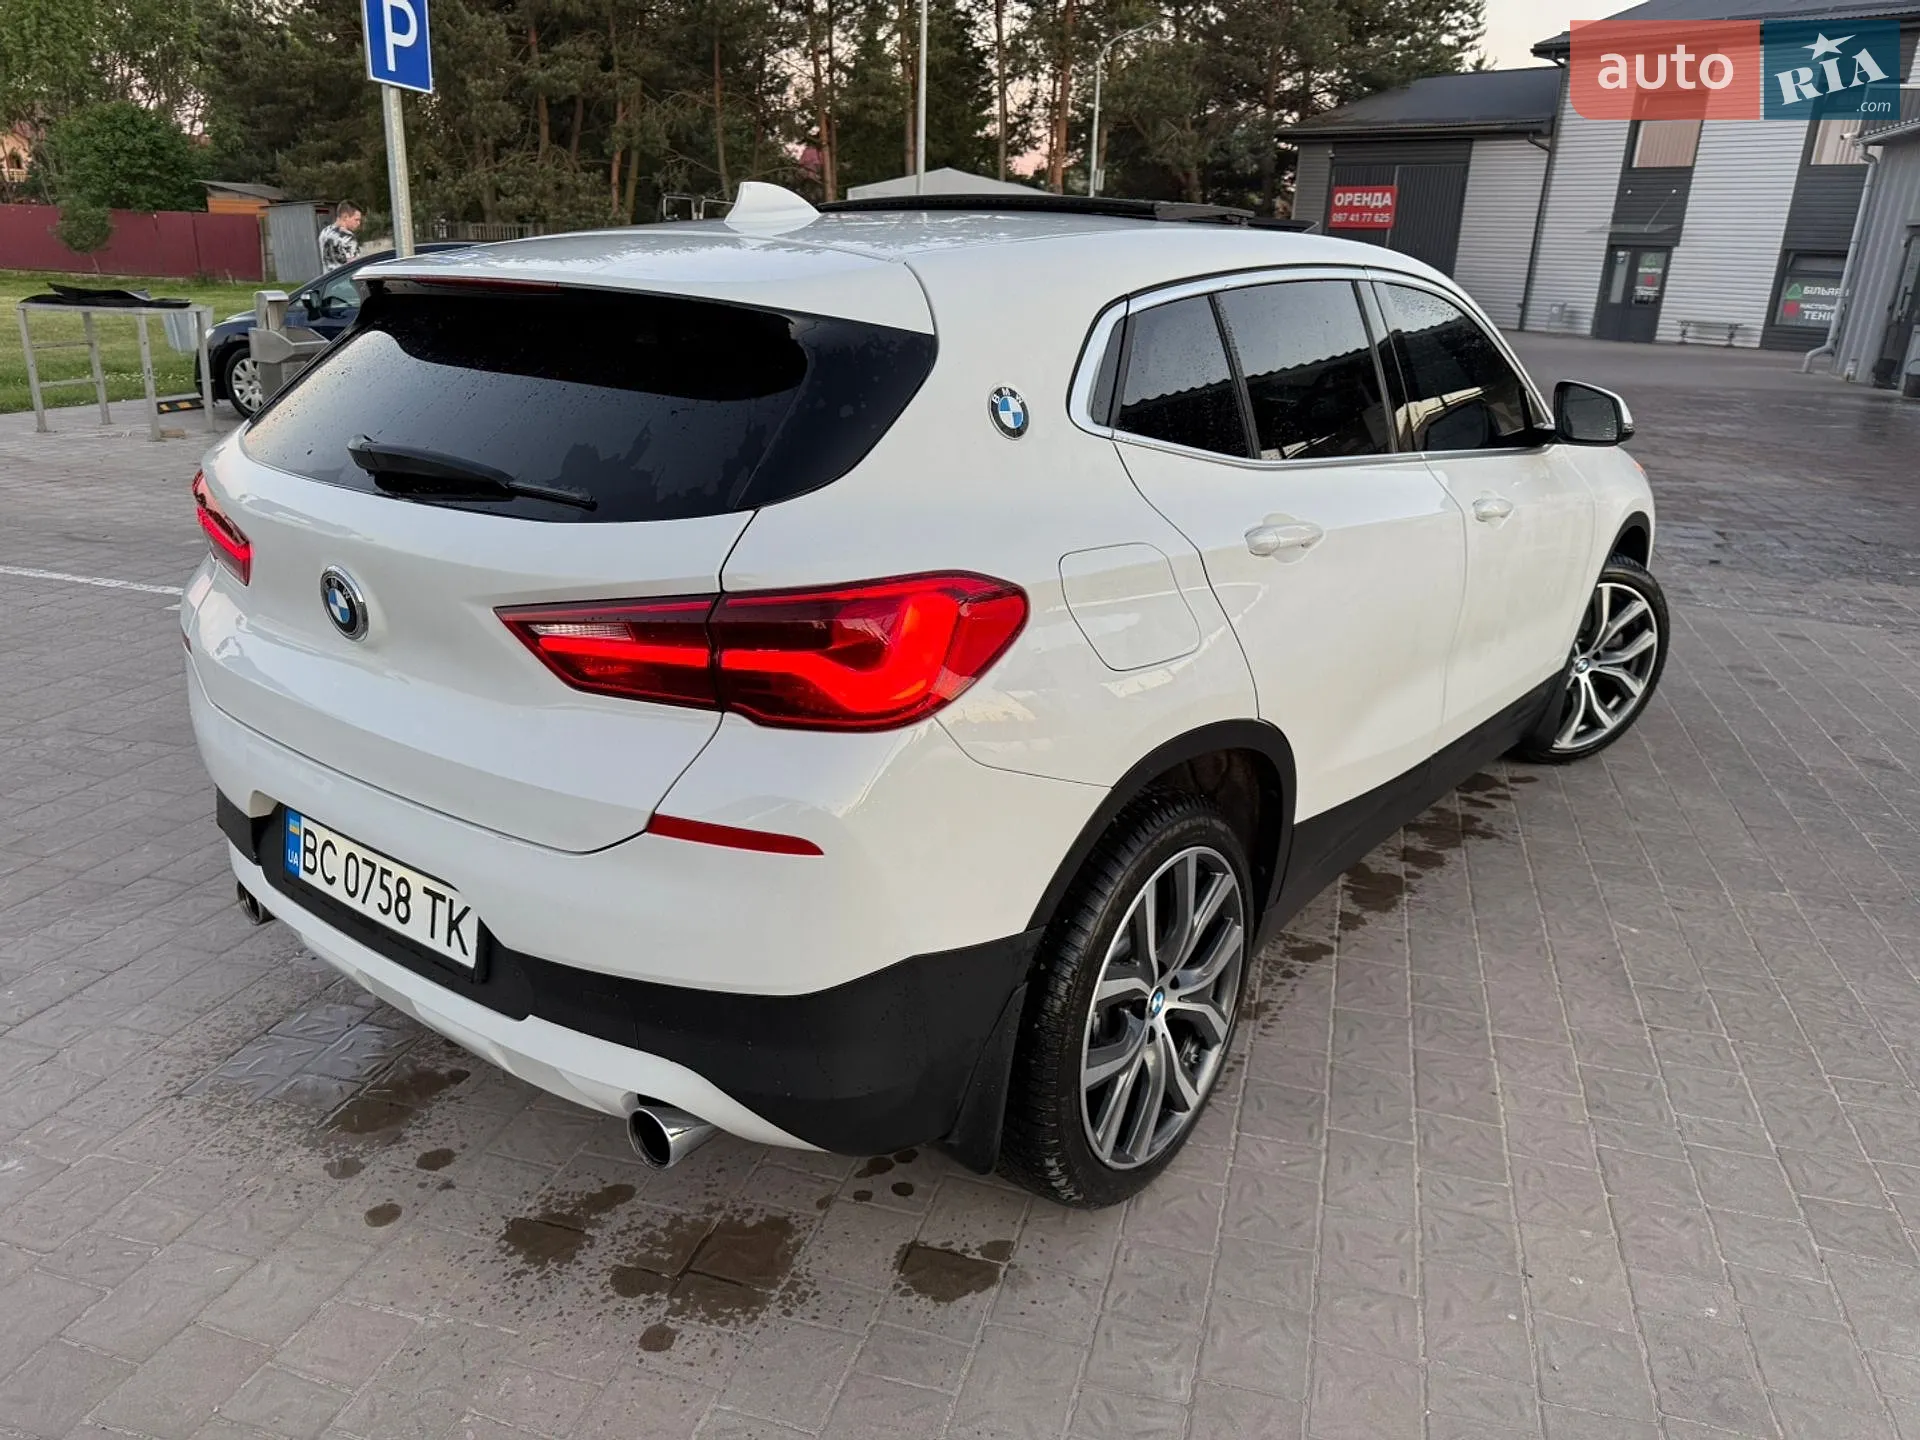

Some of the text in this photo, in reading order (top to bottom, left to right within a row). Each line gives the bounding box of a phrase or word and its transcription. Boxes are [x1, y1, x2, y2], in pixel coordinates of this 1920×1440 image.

[382, 0, 418, 72] P
[1334, 192, 1392, 208] ОРЕНДА
[1361, 213, 1373, 222] 77
[288, 849, 299, 867] UA
[302, 827, 472, 956] BC 0758 TK
